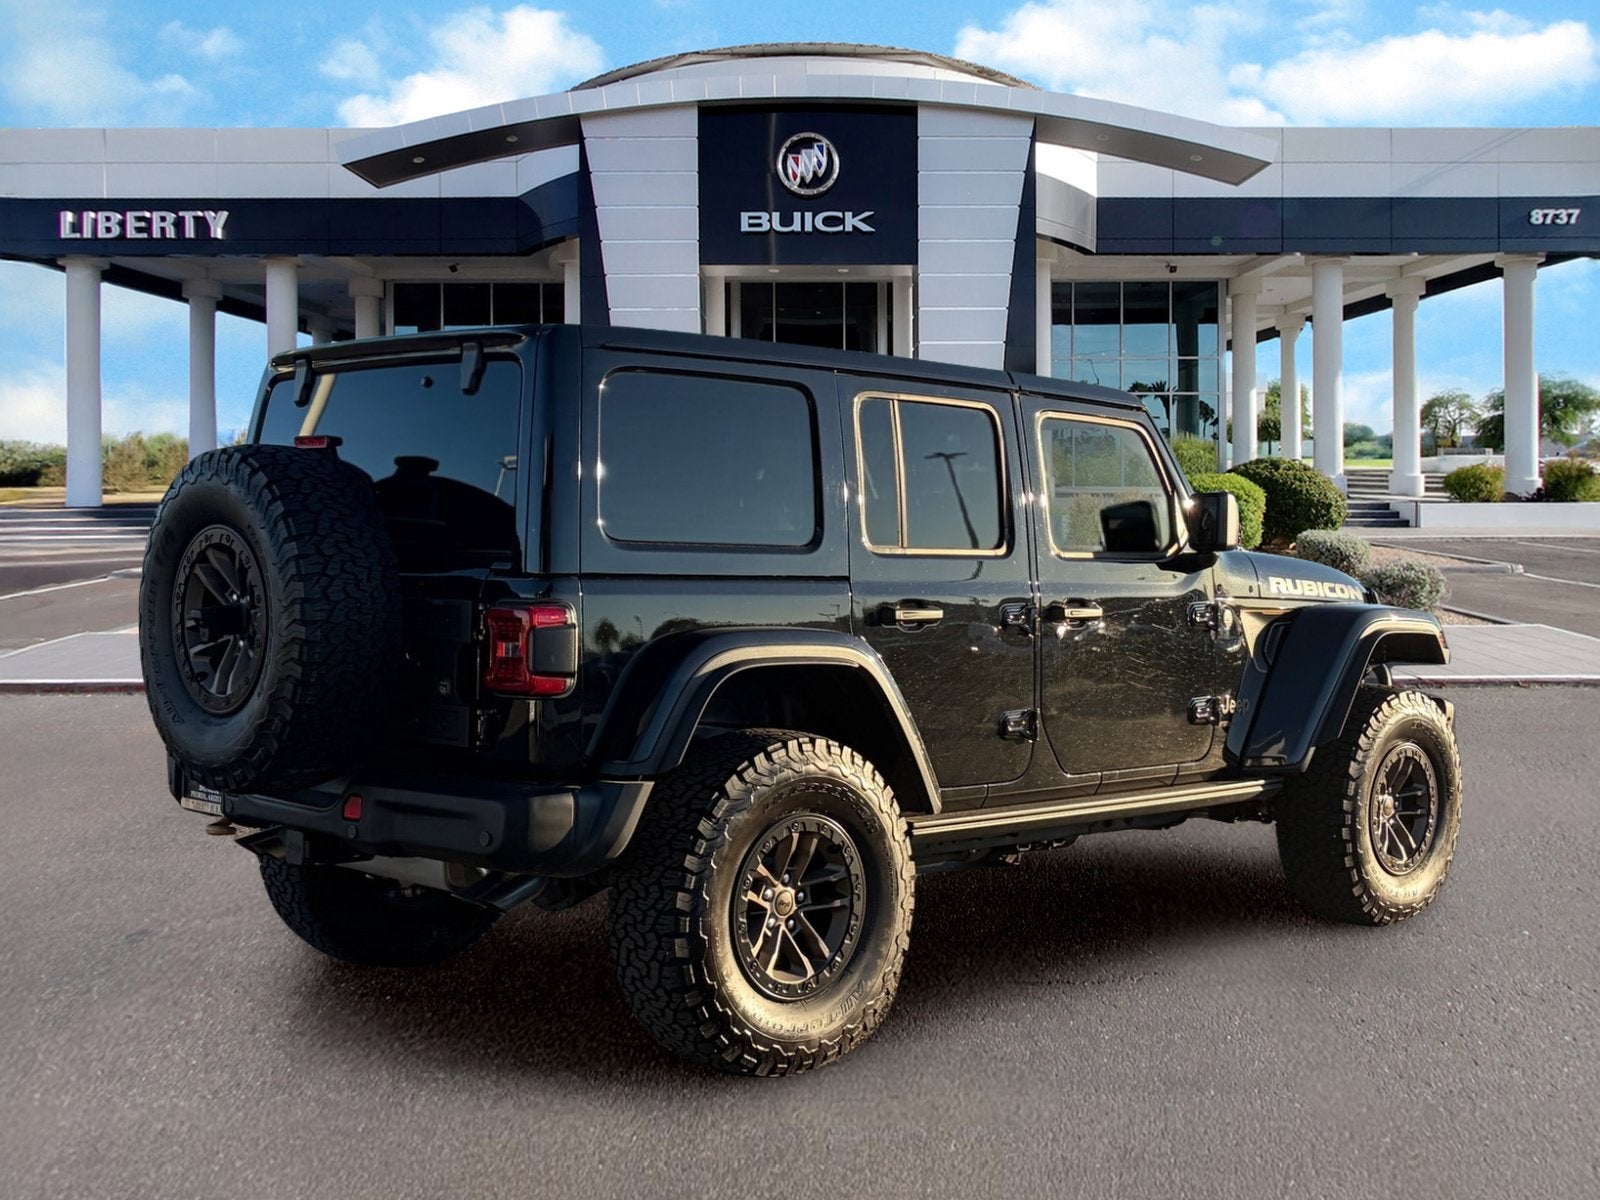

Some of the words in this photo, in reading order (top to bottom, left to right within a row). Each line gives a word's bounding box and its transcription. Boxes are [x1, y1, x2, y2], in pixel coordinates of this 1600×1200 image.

[59, 210, 229, 240] LIBERTY
[740, 211, 876, 232] BUICK
[1529, 208, 1581, 225] 8737
[1267, 576, 1364, 600] RUBICON
